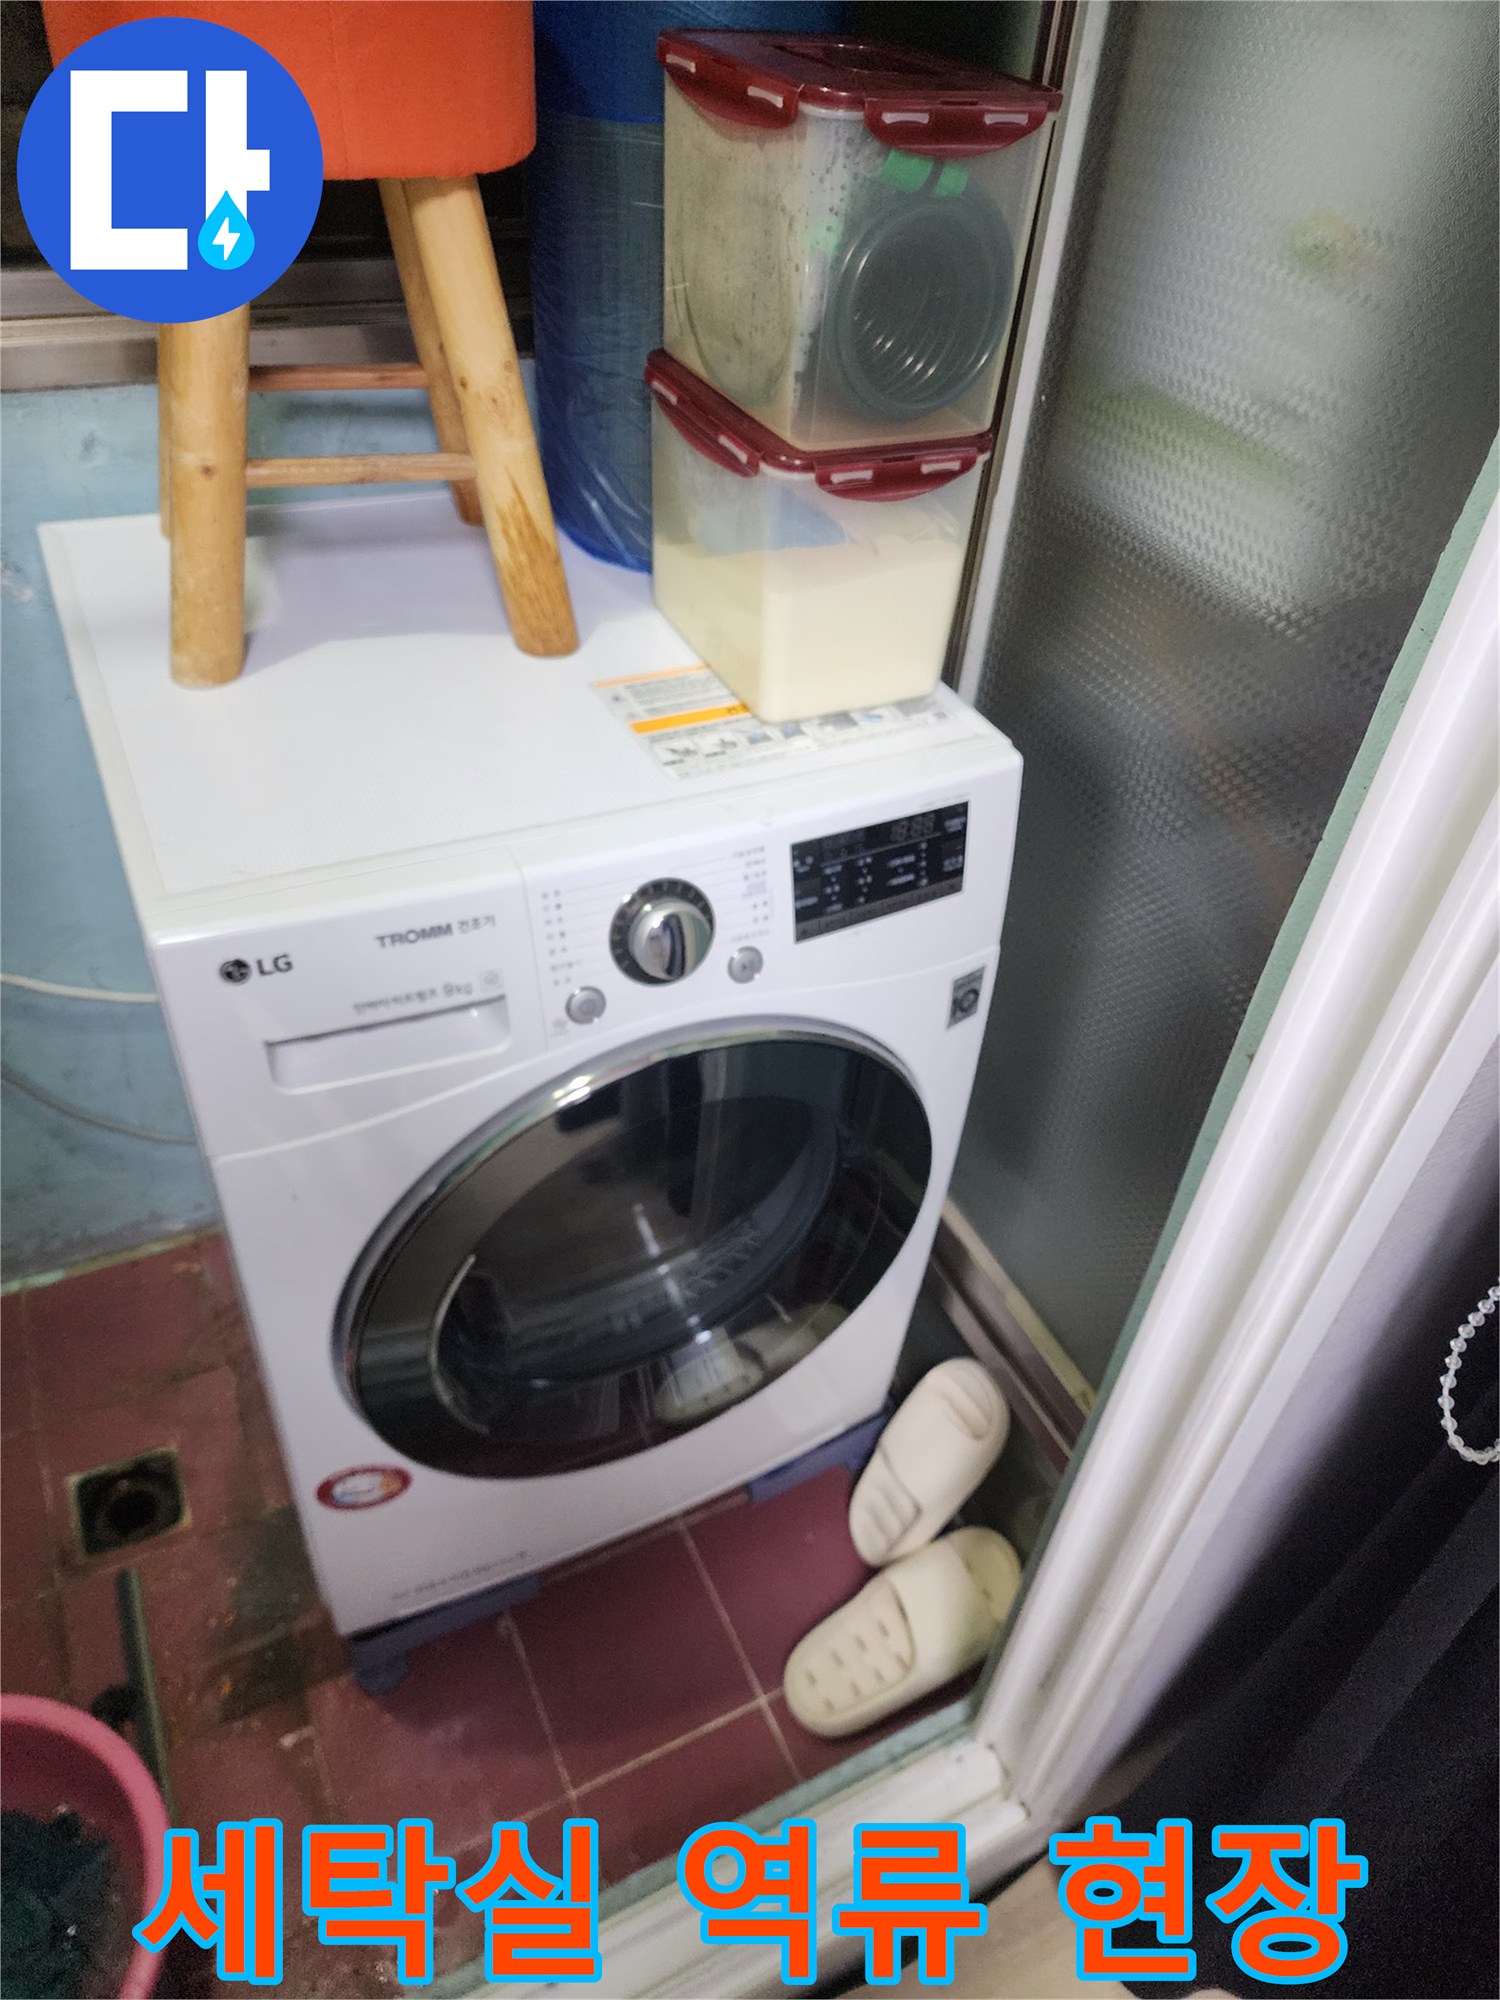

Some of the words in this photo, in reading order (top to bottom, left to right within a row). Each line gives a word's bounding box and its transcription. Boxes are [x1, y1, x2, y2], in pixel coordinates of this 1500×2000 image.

[375, 923, 454, 948] TROMM
[457, 915, 497, 934] 건조기
[256, 954, 294, 976] LG
